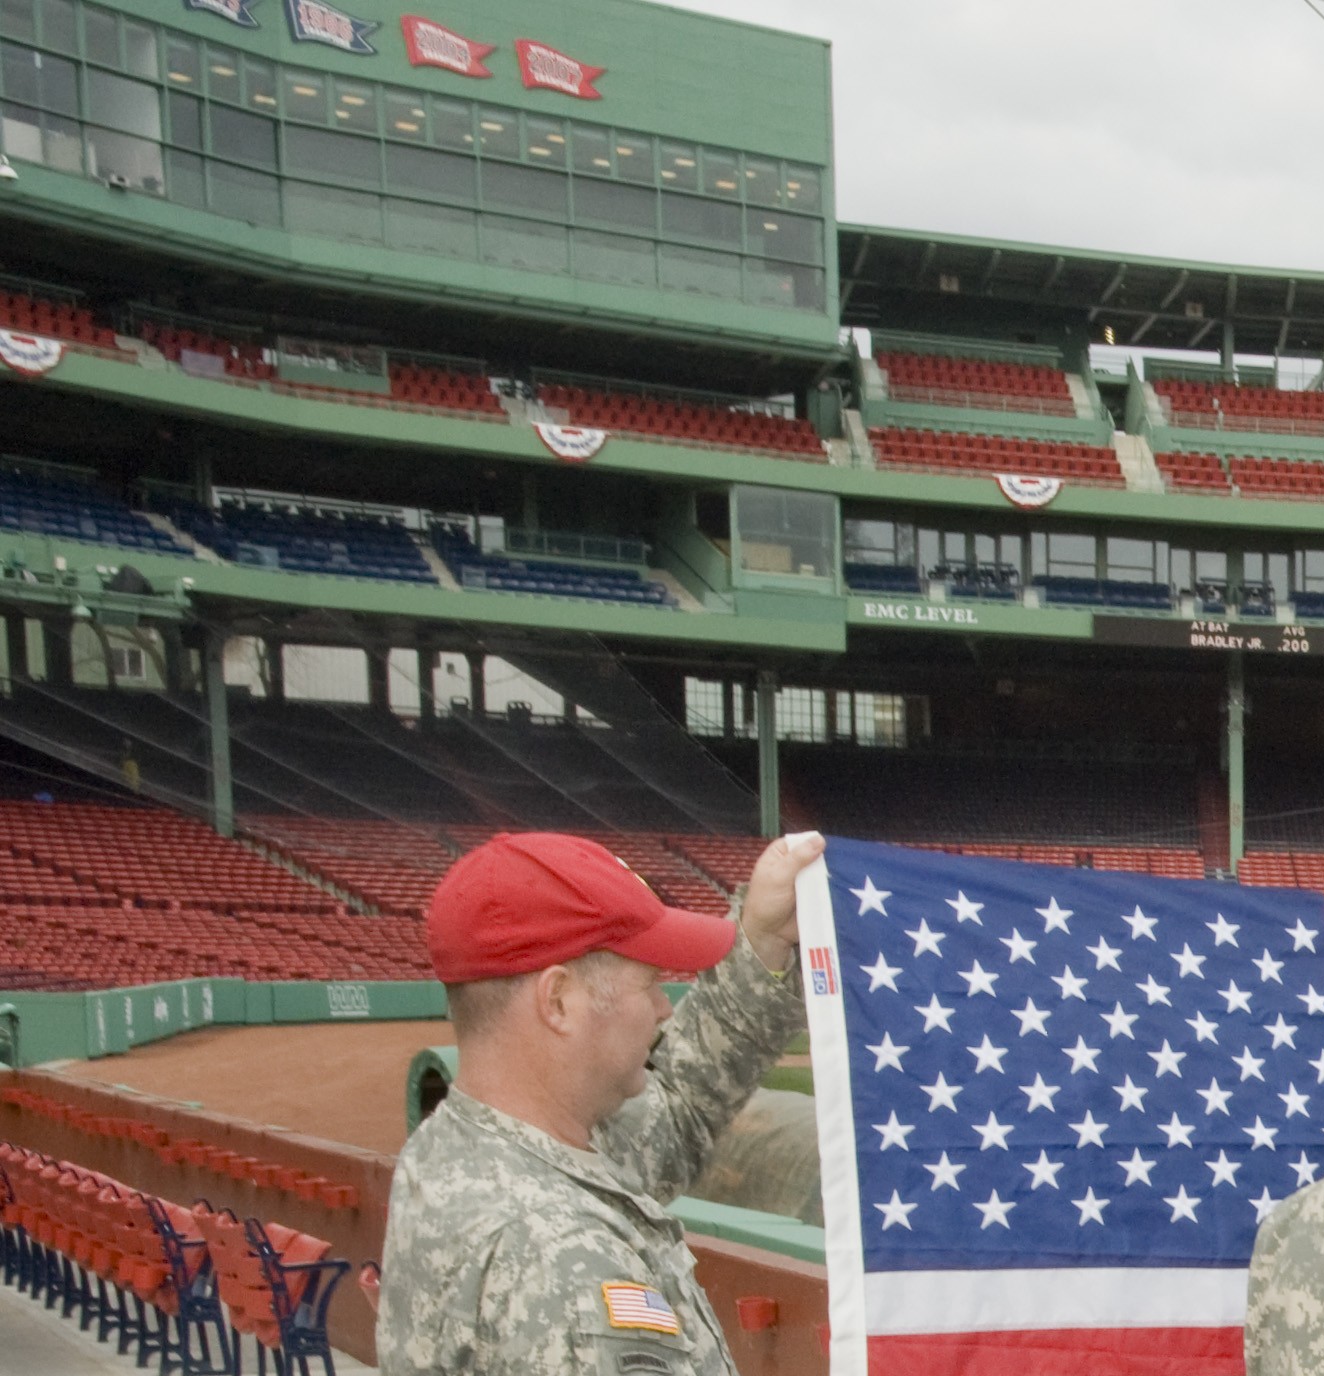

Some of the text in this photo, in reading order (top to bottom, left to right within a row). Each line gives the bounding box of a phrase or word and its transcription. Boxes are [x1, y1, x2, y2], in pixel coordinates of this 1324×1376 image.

[864, 603, 978, 624] EMC LEVEL
[1283, 626, 1305, 637] AVG
[1191, 634, 1243, 649] BRADLEY
[1247, 638, 1265, 649] JR.
[1278, 639, 1310, 653] .200
